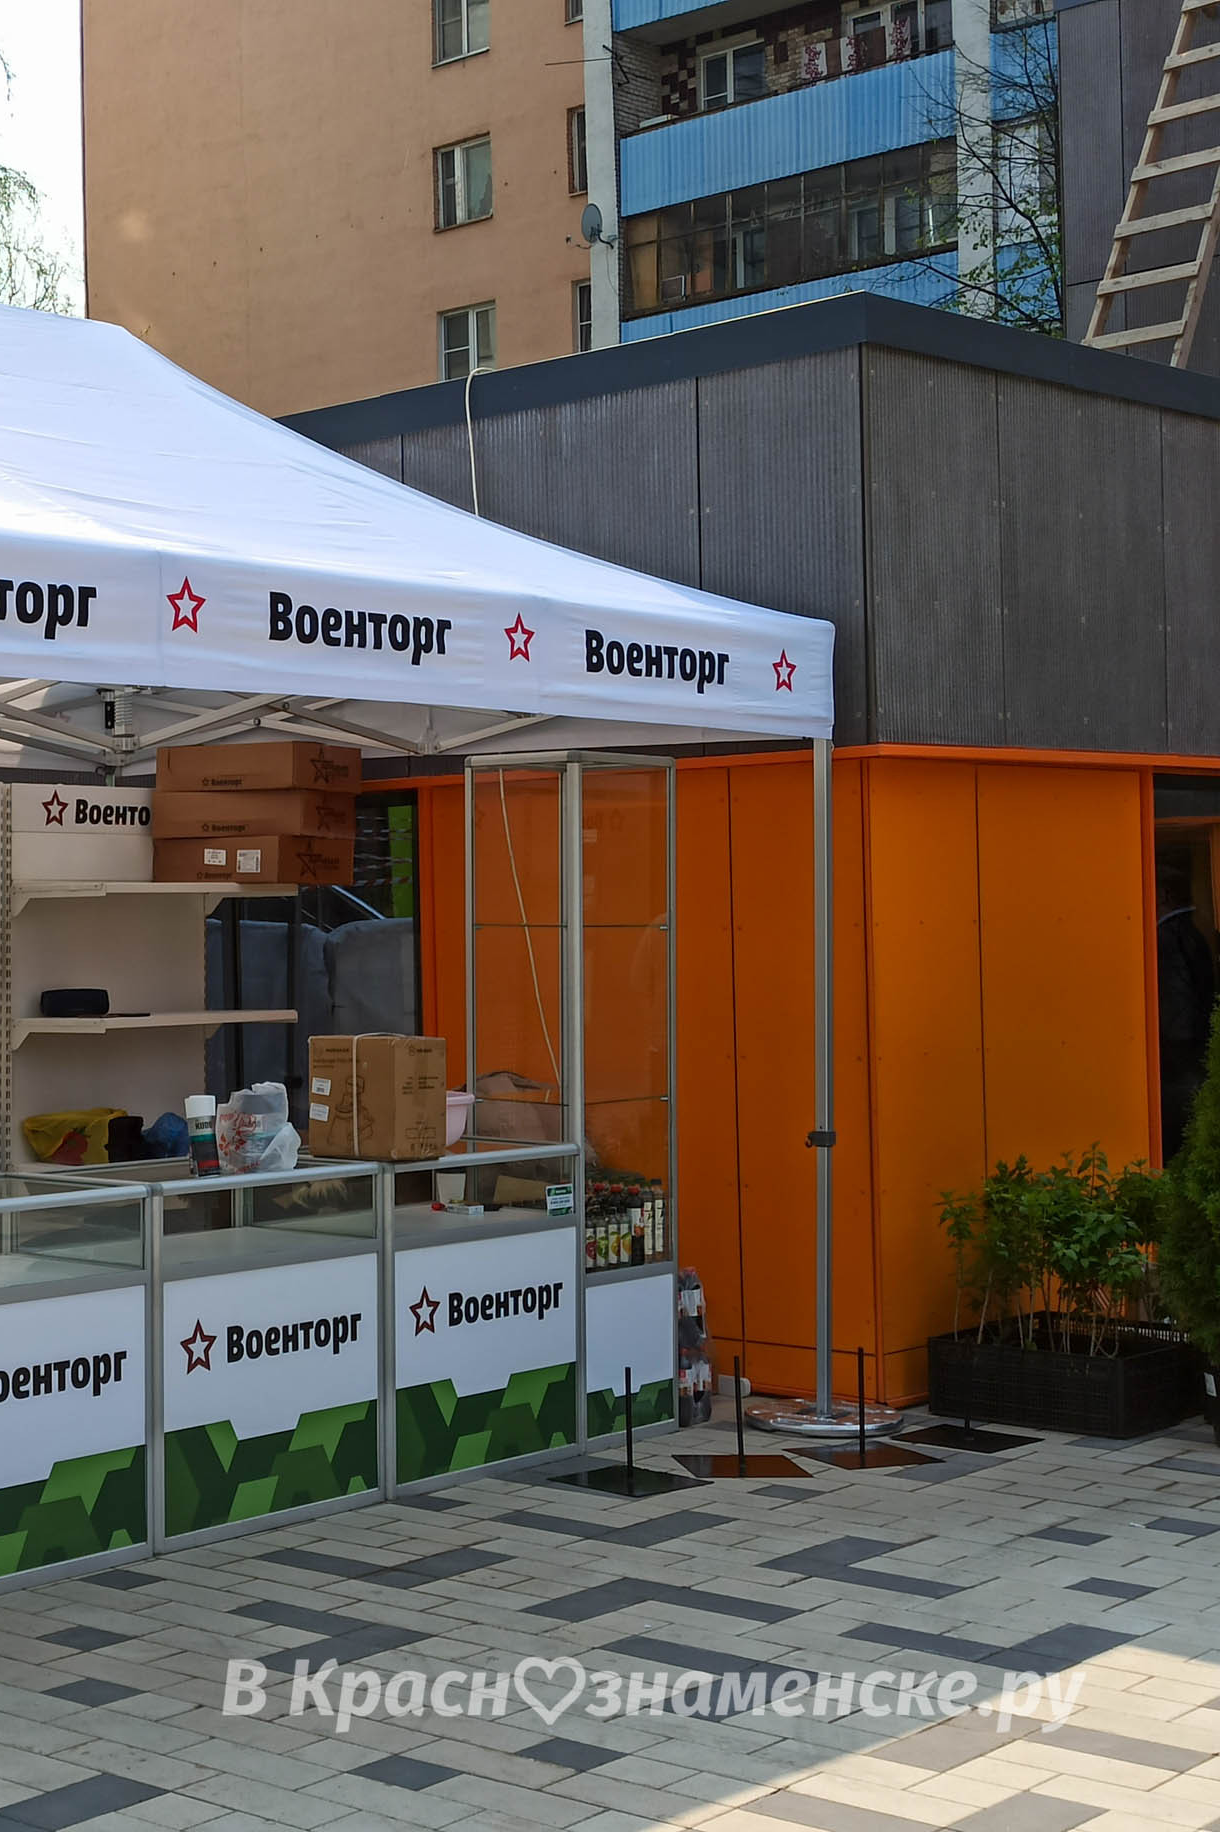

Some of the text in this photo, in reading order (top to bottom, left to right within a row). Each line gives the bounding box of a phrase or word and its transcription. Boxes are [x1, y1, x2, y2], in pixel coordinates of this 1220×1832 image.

[268, 591, 452, 666] Военторг
[585, 629, 730, 694] Военторг
[75, 798, 150, 827] Военто
[448, 1282, 563, 1327] Военторг
[226, 1312, 362, 1364] Военторг
